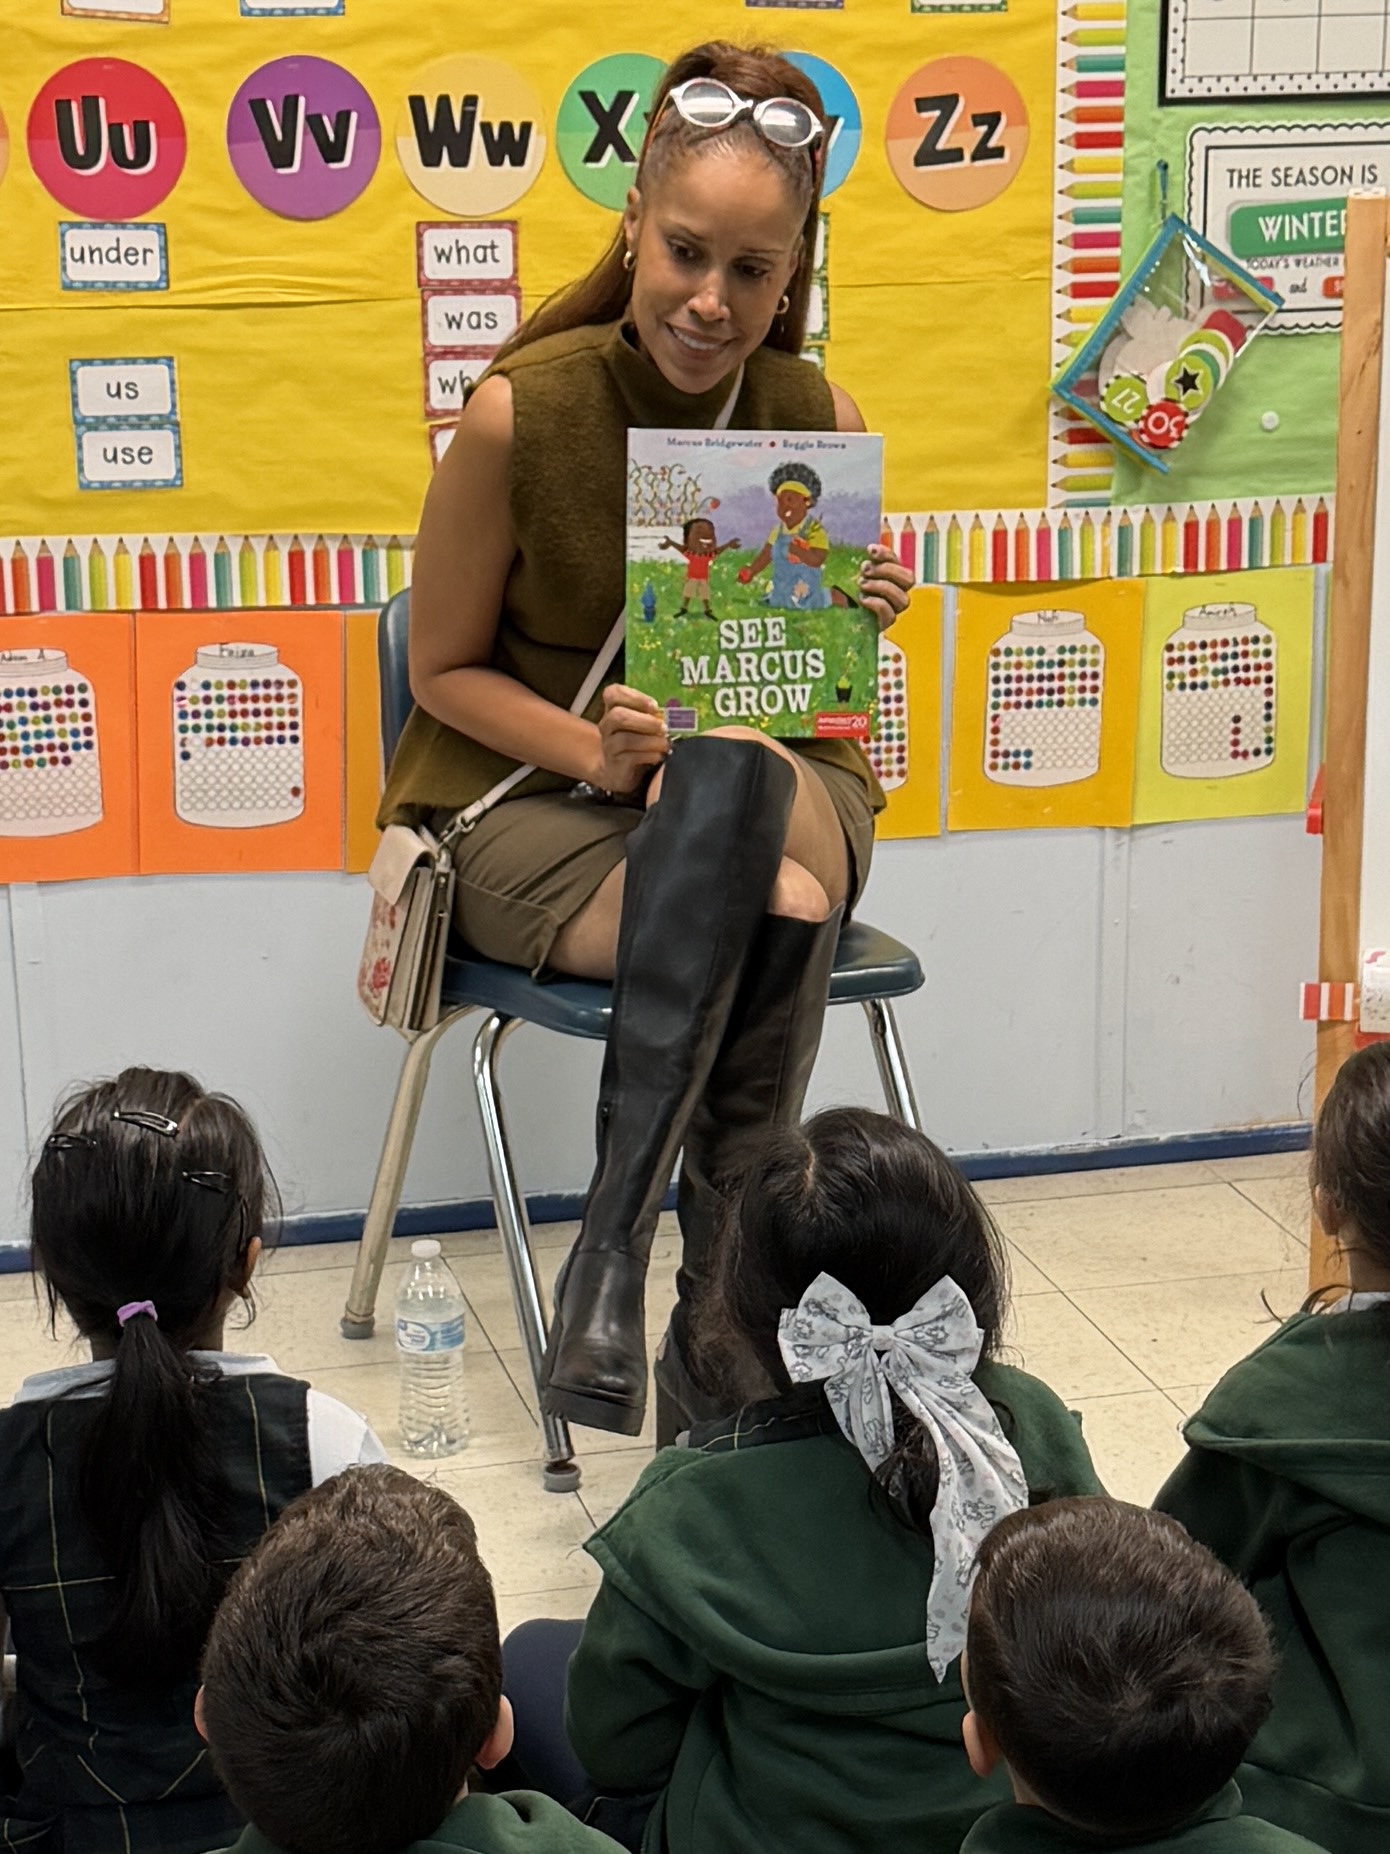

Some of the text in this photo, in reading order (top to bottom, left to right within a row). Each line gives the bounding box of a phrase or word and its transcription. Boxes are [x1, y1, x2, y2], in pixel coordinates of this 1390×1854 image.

[55, 95, 155, 174] Uu
[248, 94, 357, 173] Vv
[407, 93, 533, 169] Ww
[913, 93, 1010, 171] Zz
[1226, 164, 1378, 188] THE SEASON IS
[69, 237, 154, 265] under
[433, 239, 500, 265] what
[1293, 255, 1340, 269] WEATHER
[1289, 277, 1307, 294] and
[444, 310, 498, 330] was
[106, 381, 139, 400] us
[102, 445, 153, 465] use
[666, 437, 702, 447] Marcus
[719, 617, 786, 649] SEE
[681, 649, 826, 686] MARCUS
[714, 684, 812, 717] GROW
